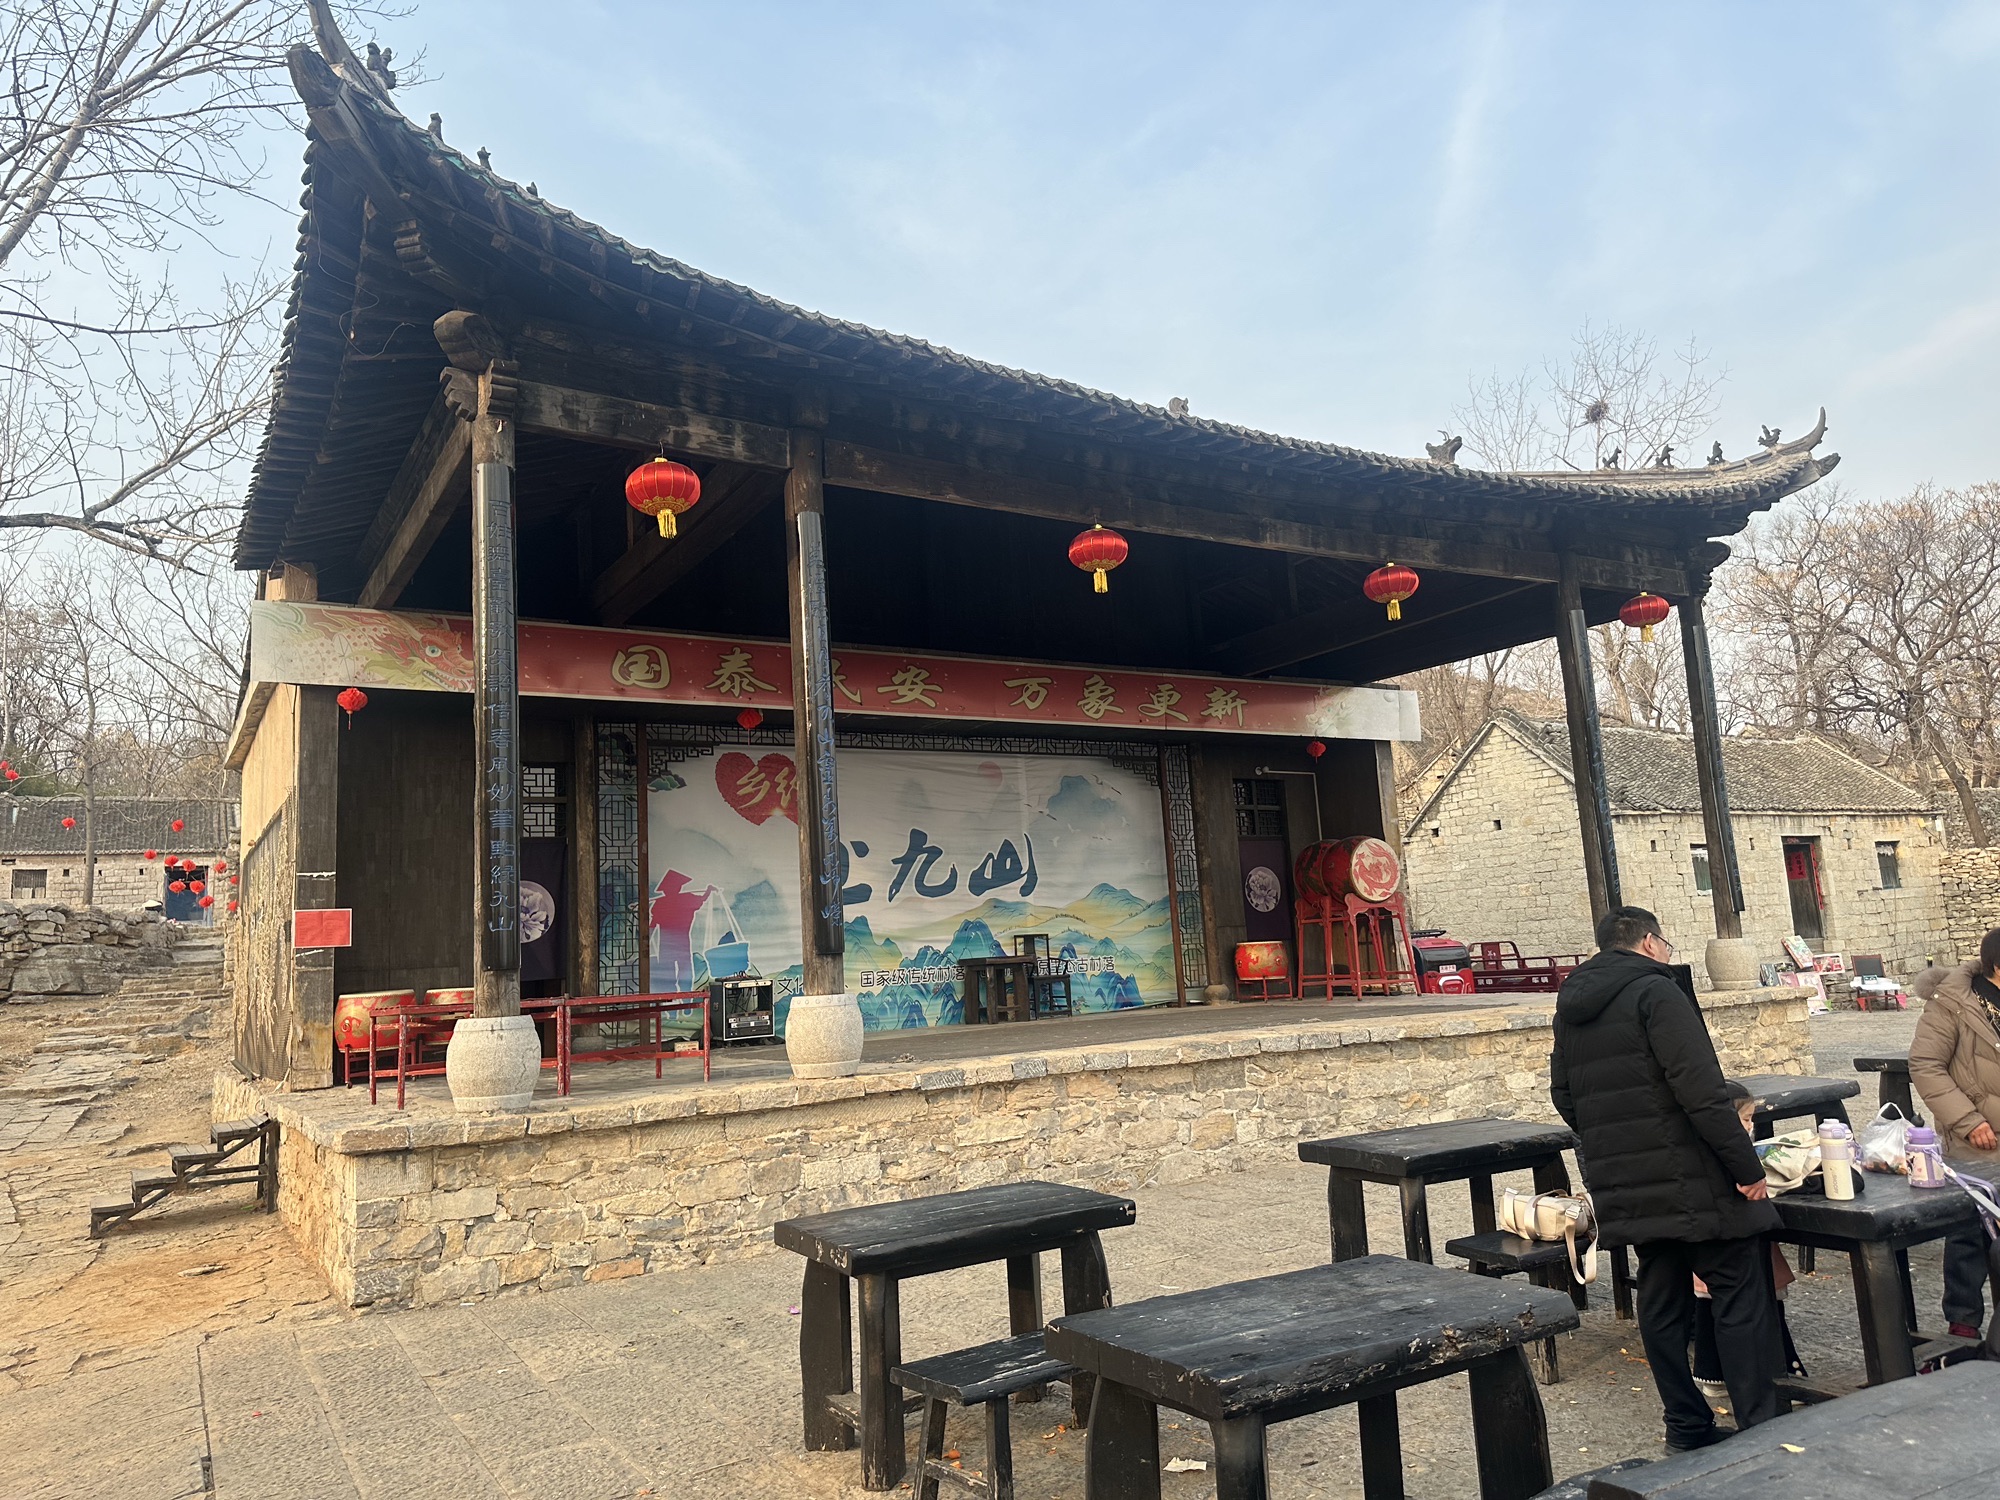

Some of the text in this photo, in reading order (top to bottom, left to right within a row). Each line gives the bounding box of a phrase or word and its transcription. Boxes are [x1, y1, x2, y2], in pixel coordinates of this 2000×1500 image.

[1003, 673, 1249, 728] 万象更新
[860, 963, 966, 989] 国家级传统村落
